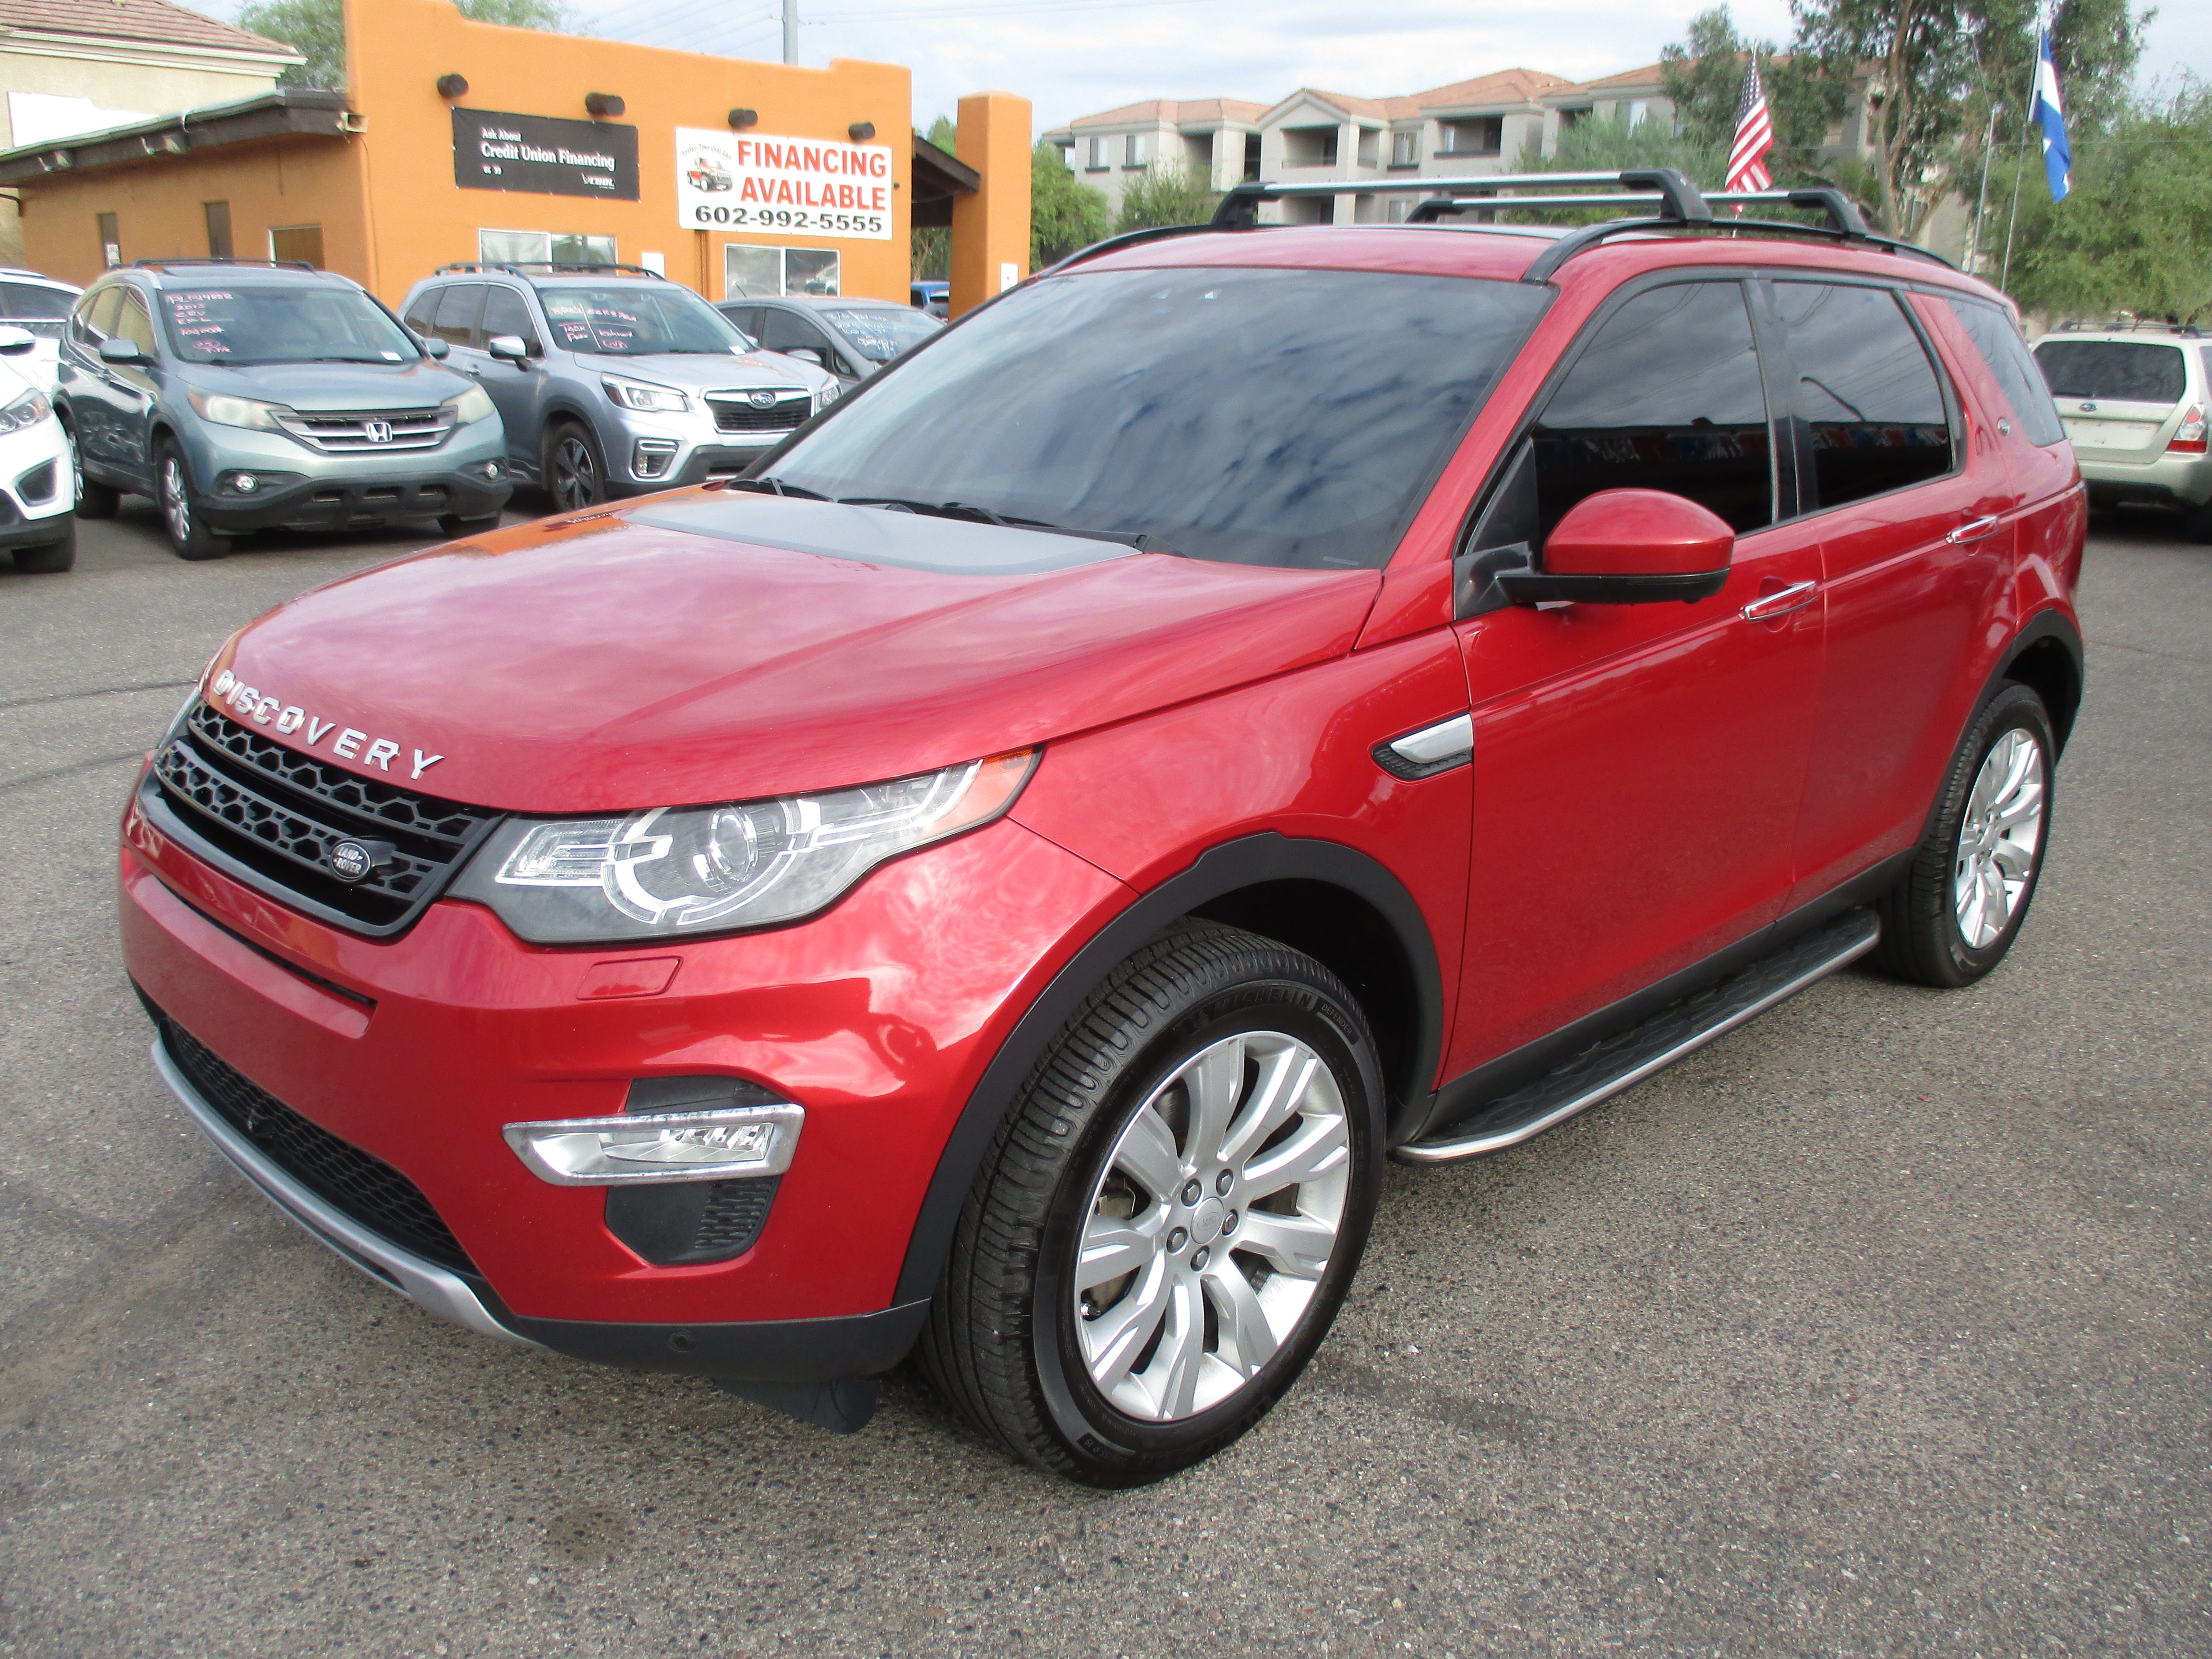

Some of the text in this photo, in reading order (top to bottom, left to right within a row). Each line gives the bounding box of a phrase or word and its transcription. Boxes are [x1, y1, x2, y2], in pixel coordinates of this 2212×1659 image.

[482, 127, 522, 142] Ask About
[481, 143, 615, 171] Credit Union Financing
[738, 141, 886, 178] FINANCING
[741, 177, 886, 211] AVAILABLE
[695, 205, 883, 232] 602-992-5555
[214, 669, 445, 781] DISCOVERY
[336, 857, 363, 875] ROVER
[337, 846, 360, 860] LAND
[1321, 1003, 1354, 1036] DEFENDER
